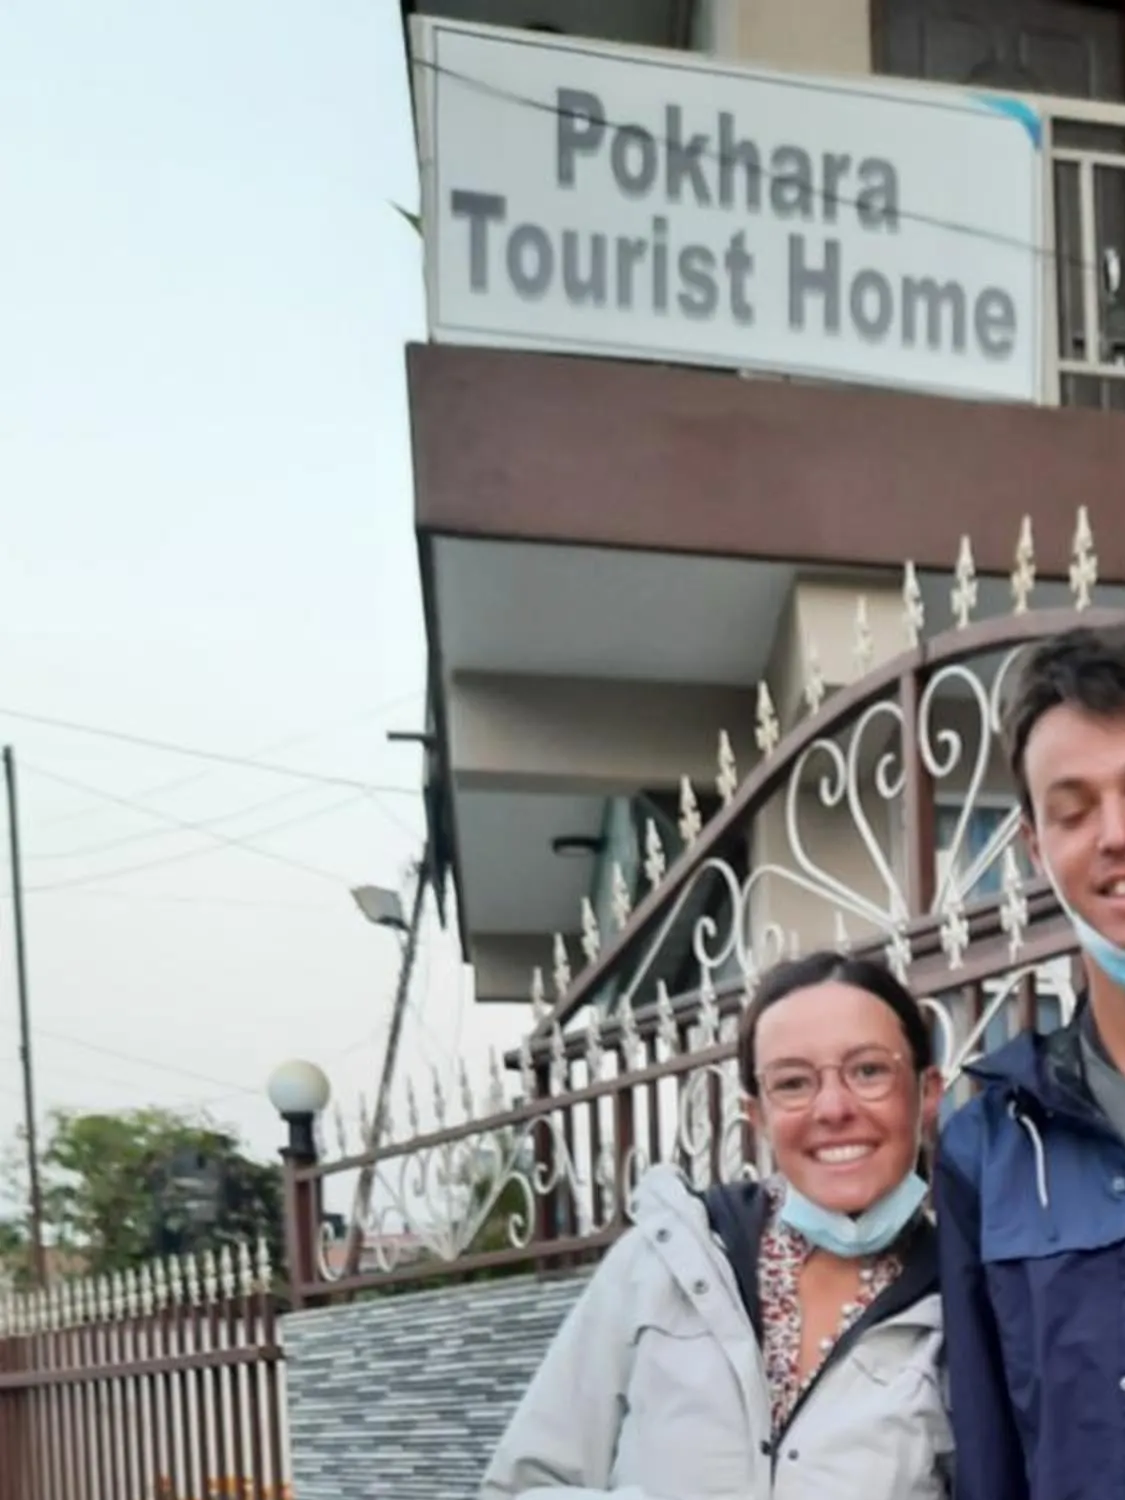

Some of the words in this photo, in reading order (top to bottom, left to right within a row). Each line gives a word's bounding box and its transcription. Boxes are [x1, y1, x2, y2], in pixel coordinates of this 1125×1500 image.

[554, 88, 901, 234] Pokhara
[450, 190, 755, 326] Tourist
[788, 234, 1018, 361] Home
